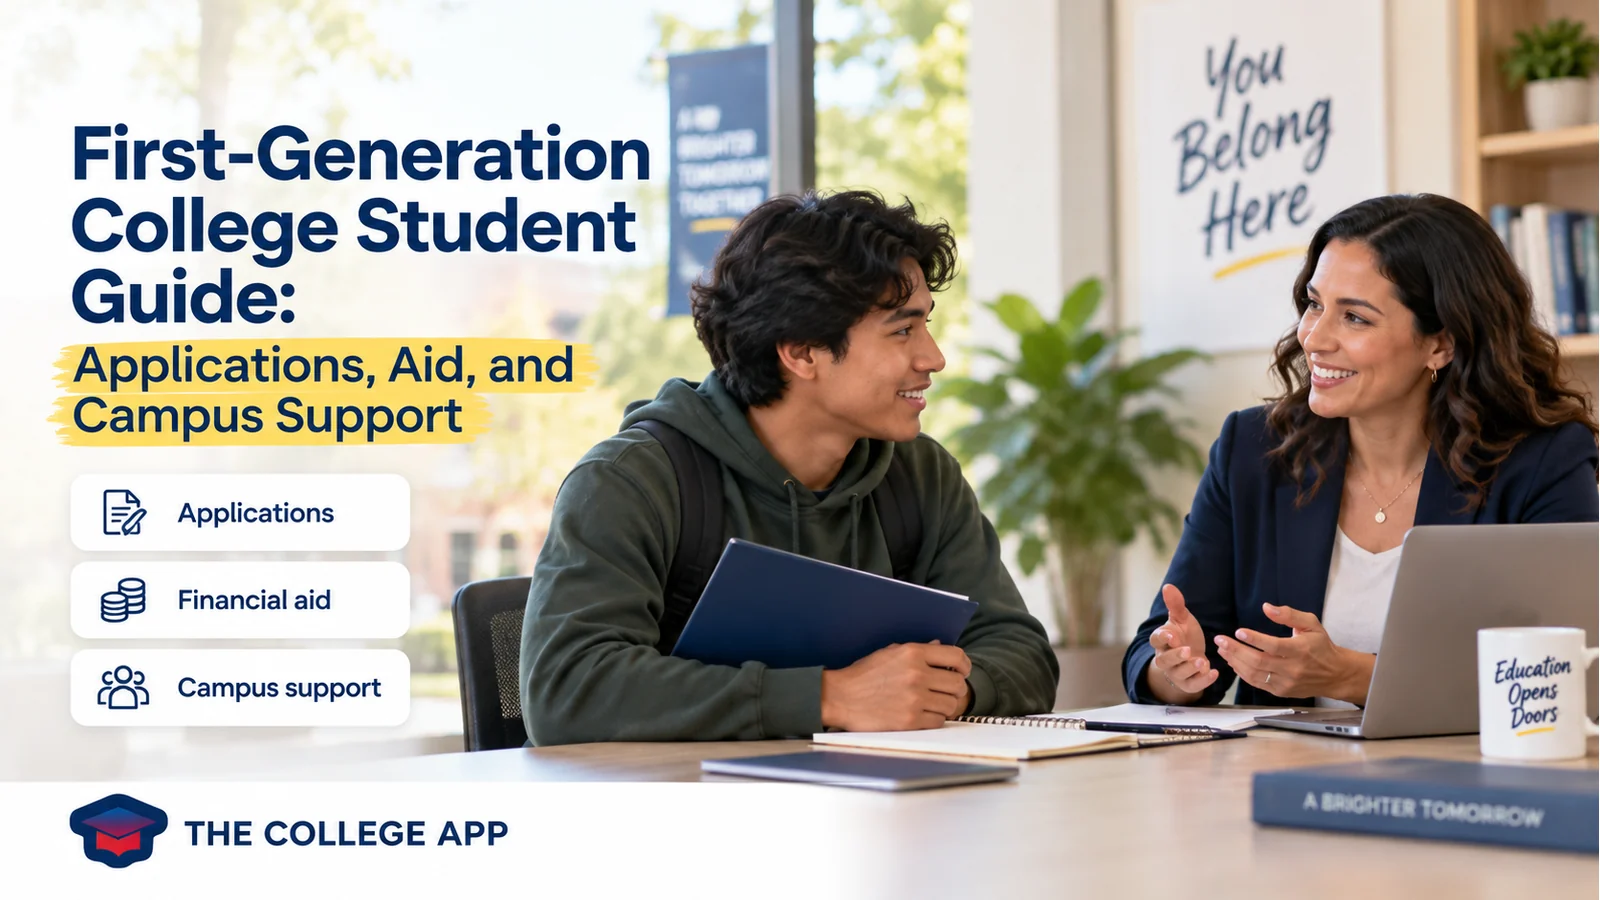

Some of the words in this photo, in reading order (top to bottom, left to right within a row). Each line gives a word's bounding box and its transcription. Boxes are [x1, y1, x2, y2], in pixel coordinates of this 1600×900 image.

[1206, 37, 1284, 118] You
[1174, 98, 1332, 195] Belong
[1201, 181, 1313, 257] Here
[1495, 656, 1571, 684] Education
[1508, 683, 1558, 708] Opens
[1511, 706, 1558, 729] Doors
[1303, 791, 1318, 811] A
[1321, 791, 1417, 819] BRIGHTER
[1421, 799, 1544, 828] TOMORROW
